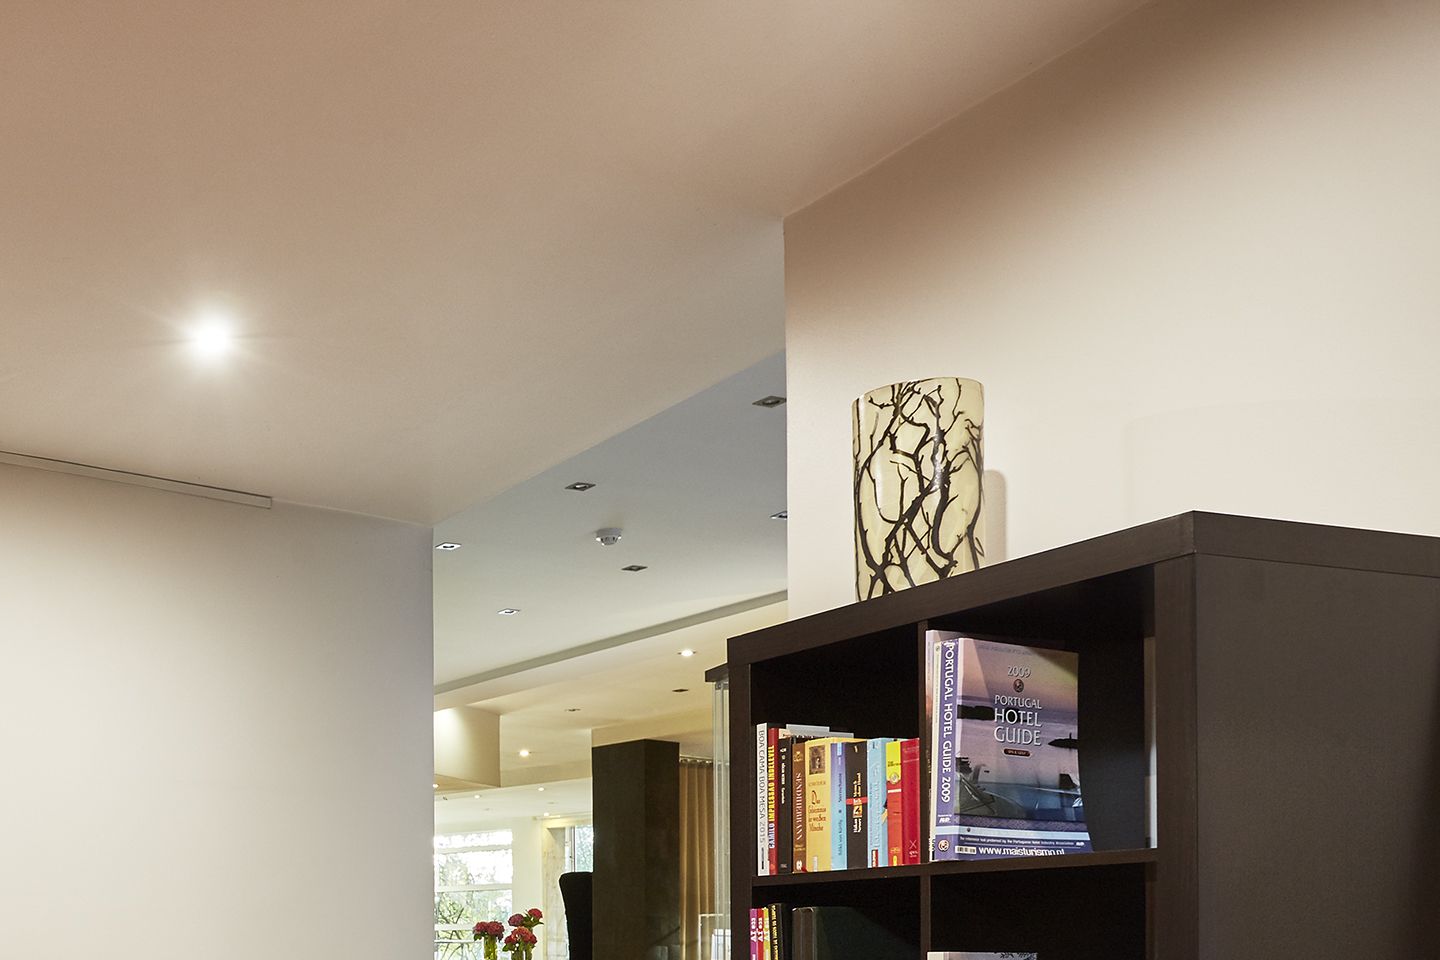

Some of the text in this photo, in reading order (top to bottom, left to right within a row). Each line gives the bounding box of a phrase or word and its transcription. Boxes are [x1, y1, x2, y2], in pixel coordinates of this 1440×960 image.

[1007, 666, 1032, 678] 2009
[994, 694, 1042, 709] PORTUGAL
[941, 643, 954, 803] PORTUGAL HOTEL GUIDE 2009
[993, 708, 1042, 727] HOTEL
[993, 726, 1042, 746] GUIDE
